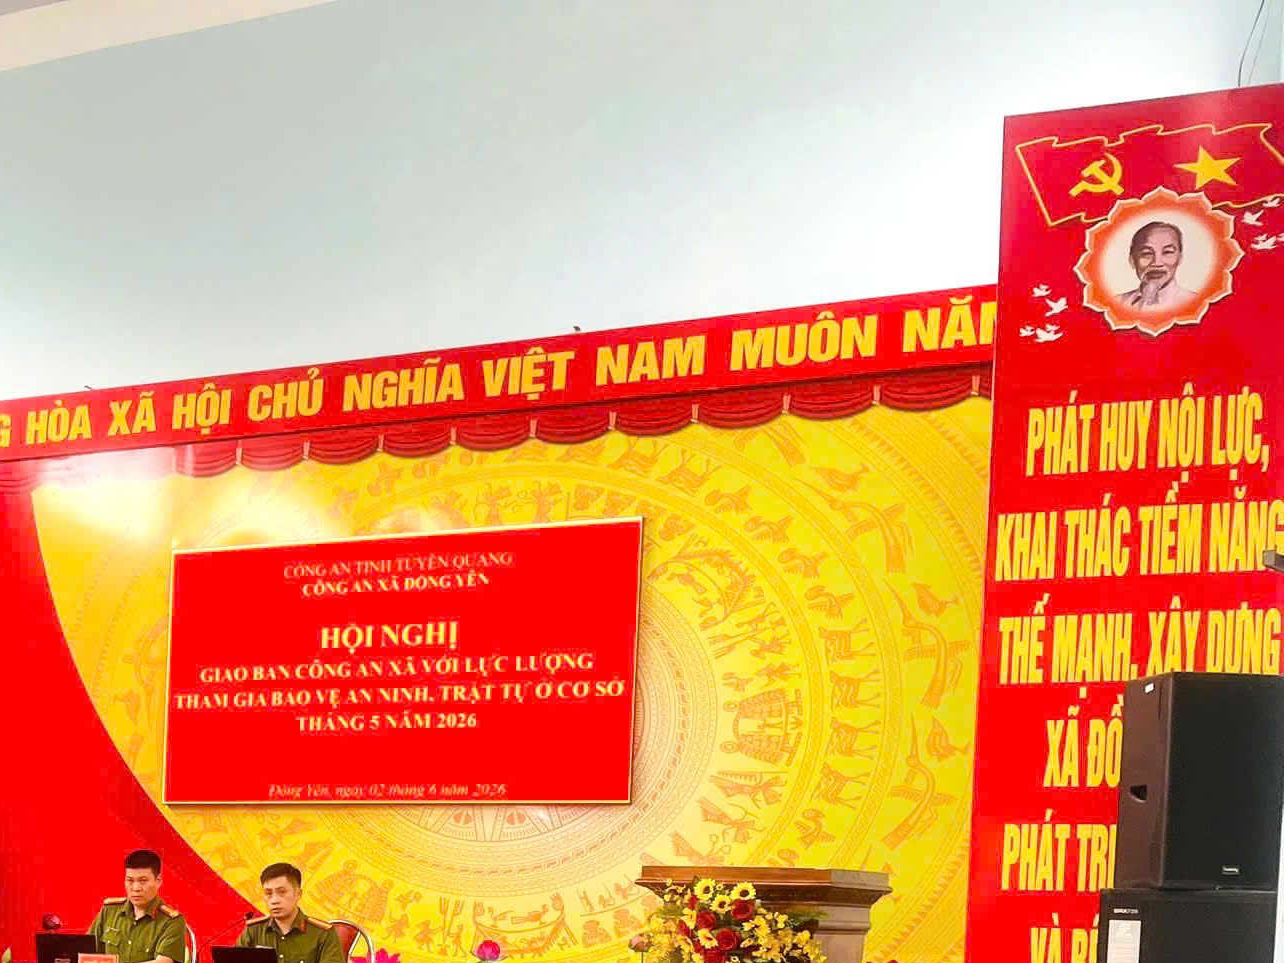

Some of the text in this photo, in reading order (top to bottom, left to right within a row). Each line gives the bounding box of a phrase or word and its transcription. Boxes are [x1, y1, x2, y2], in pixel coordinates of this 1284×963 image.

[26, 400, 92, 445] HÒA
[108, 391, 157, 437] XÃ
[172, 382, 232, 435] HỘI
[248, 367, 324, 422] CHỦ
[342, 357, 465, 412] NGHĨA
[483, 346, 575, 401] VIỆT
[595, 335, 706, 385] NAM
[730, 311, 878, 372] MUÔN
[1026, 382, 1270, 483] PHÁT HUY NỘI LỰC,
[995, 511, 1058, 582] KHAI
[1064, 493, 1131, 578] THÁC
[1138, 481, 1203, 576] TIỀM
[284, 560, 327, 578] CÔNG
[329, 562, 351, 575] AN
[452, 552, 514, 569] QUANG
[302, 578, 348, 598] CÔNG
[350, 580, 373, 592] AN
[377, 575, 400, 593] XÃ
[454, 569, 491, 587] YÊN
[200, 651, 595, 683] GIAO BAN CÔNG AN XÃ VỚI LỰC LƯỢNG
[320, 620, 459, 656] HỘI NGHỊ
[999, 592, 1050, 685] THẾ
[1145, 595, 1201, 677] XÂY
[175, 692, 229, 710] THAM
[233, 691, 267, 708] GIA
[316, 686, 341, 709] VỆ
[346, 688, 372, 704] AN
[439, 682, 494, 705] TRẬT
[500, 680, 533, 704] TỰ
[557, 680, 591, 698] CƠ
[595, 673, 626, 697] SỞ
[299, 711, 477, 732] THÁNG 5 NĂM 2026
[1044, 694, 1124, 788] XÃ ĐỒ
[1001, 809, 1117, 892] PHÁT TRI
